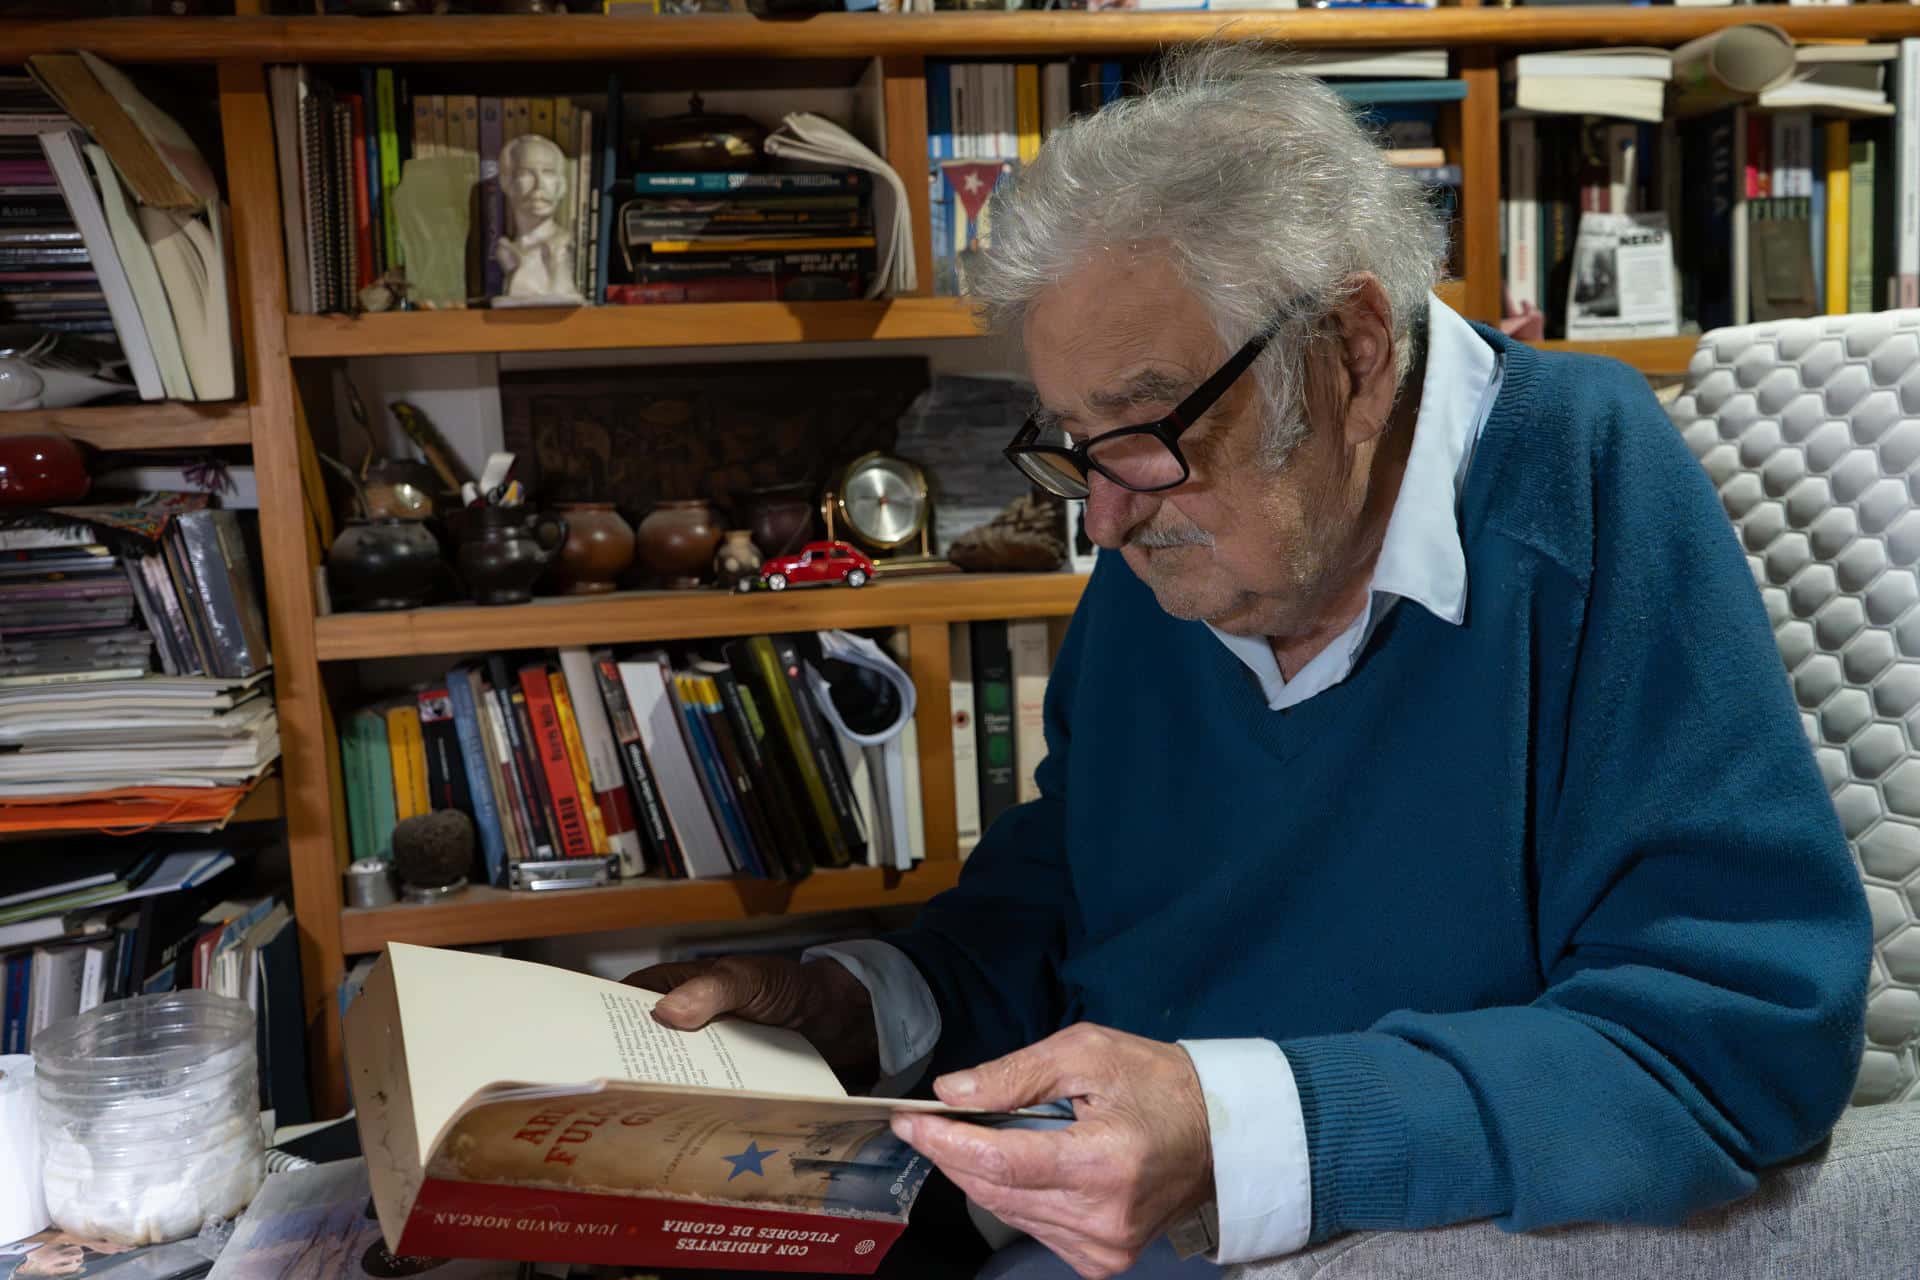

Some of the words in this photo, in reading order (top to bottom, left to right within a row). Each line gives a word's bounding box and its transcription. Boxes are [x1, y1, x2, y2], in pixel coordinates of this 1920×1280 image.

[433, 1212, 512, 1230] MORGAN
[515, 1216, 572, 1233] DAVID
[661, 1219, 726, 1235] GLORIA
[574, 1222, 619, 1237] JUAN
[729, 1224, 753, 1238] DE
[757, 1227, 840, 1244] FULGORES
[675, 1237, 773, 1255] ARDIENTES
[775, 1244, 809, 1257] CON
